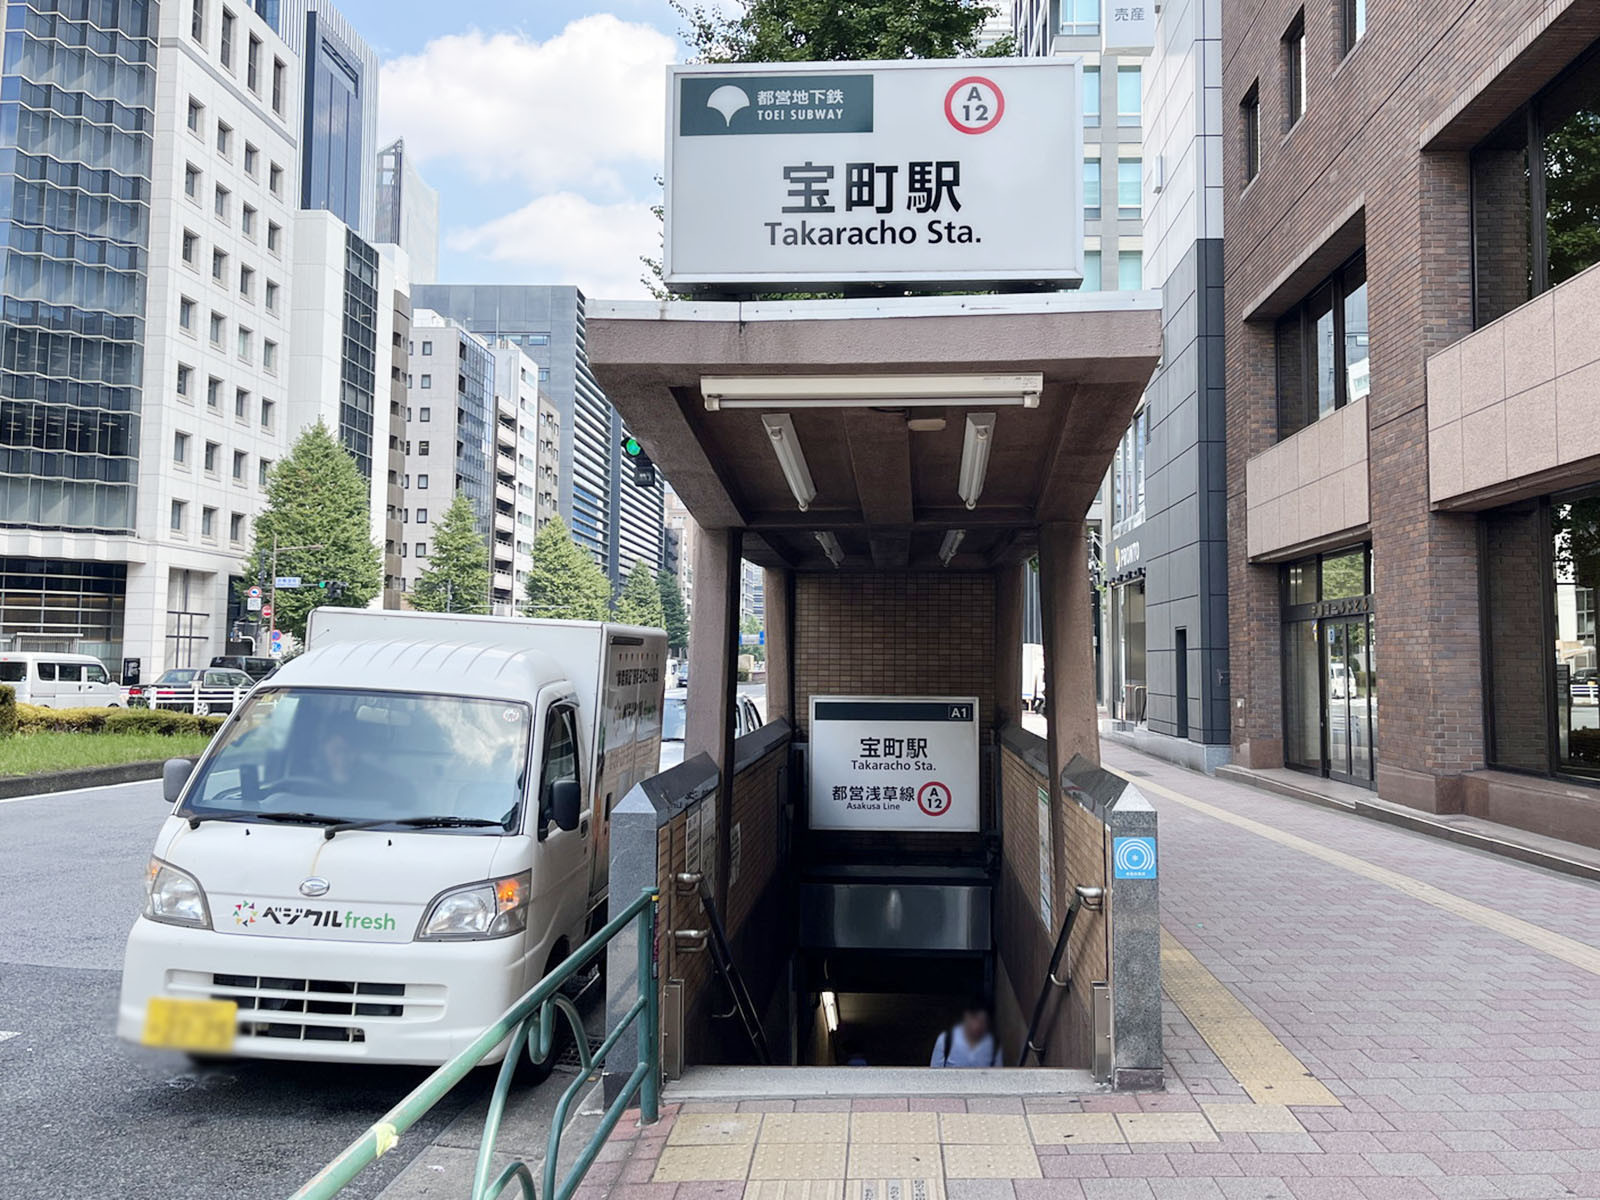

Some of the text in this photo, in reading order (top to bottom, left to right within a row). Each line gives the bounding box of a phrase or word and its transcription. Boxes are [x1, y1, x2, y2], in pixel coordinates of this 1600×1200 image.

[757, 88, 844, 106] 都営地下鉄
[966, 86, 982, 101] A
[757, 108, 844, 121] TOEI SUBWAY
[961, 104, 989, 121] 12
[781, 160, 961, 214] 宝町駅
[764, 219, 982, 246] Takaracho Sta.
[951, 707, 967, 718] A1
[859, 737, 928, 759] 宝町駅
[851, 760, 937, 771] Takaracho Sta.
[832, 785, 915, 802] 都営浅草線
[929, 787, 939, 797] A
[846, 802, 901, 810] Asakusa Line
[927, 799, 943, 809] 12
